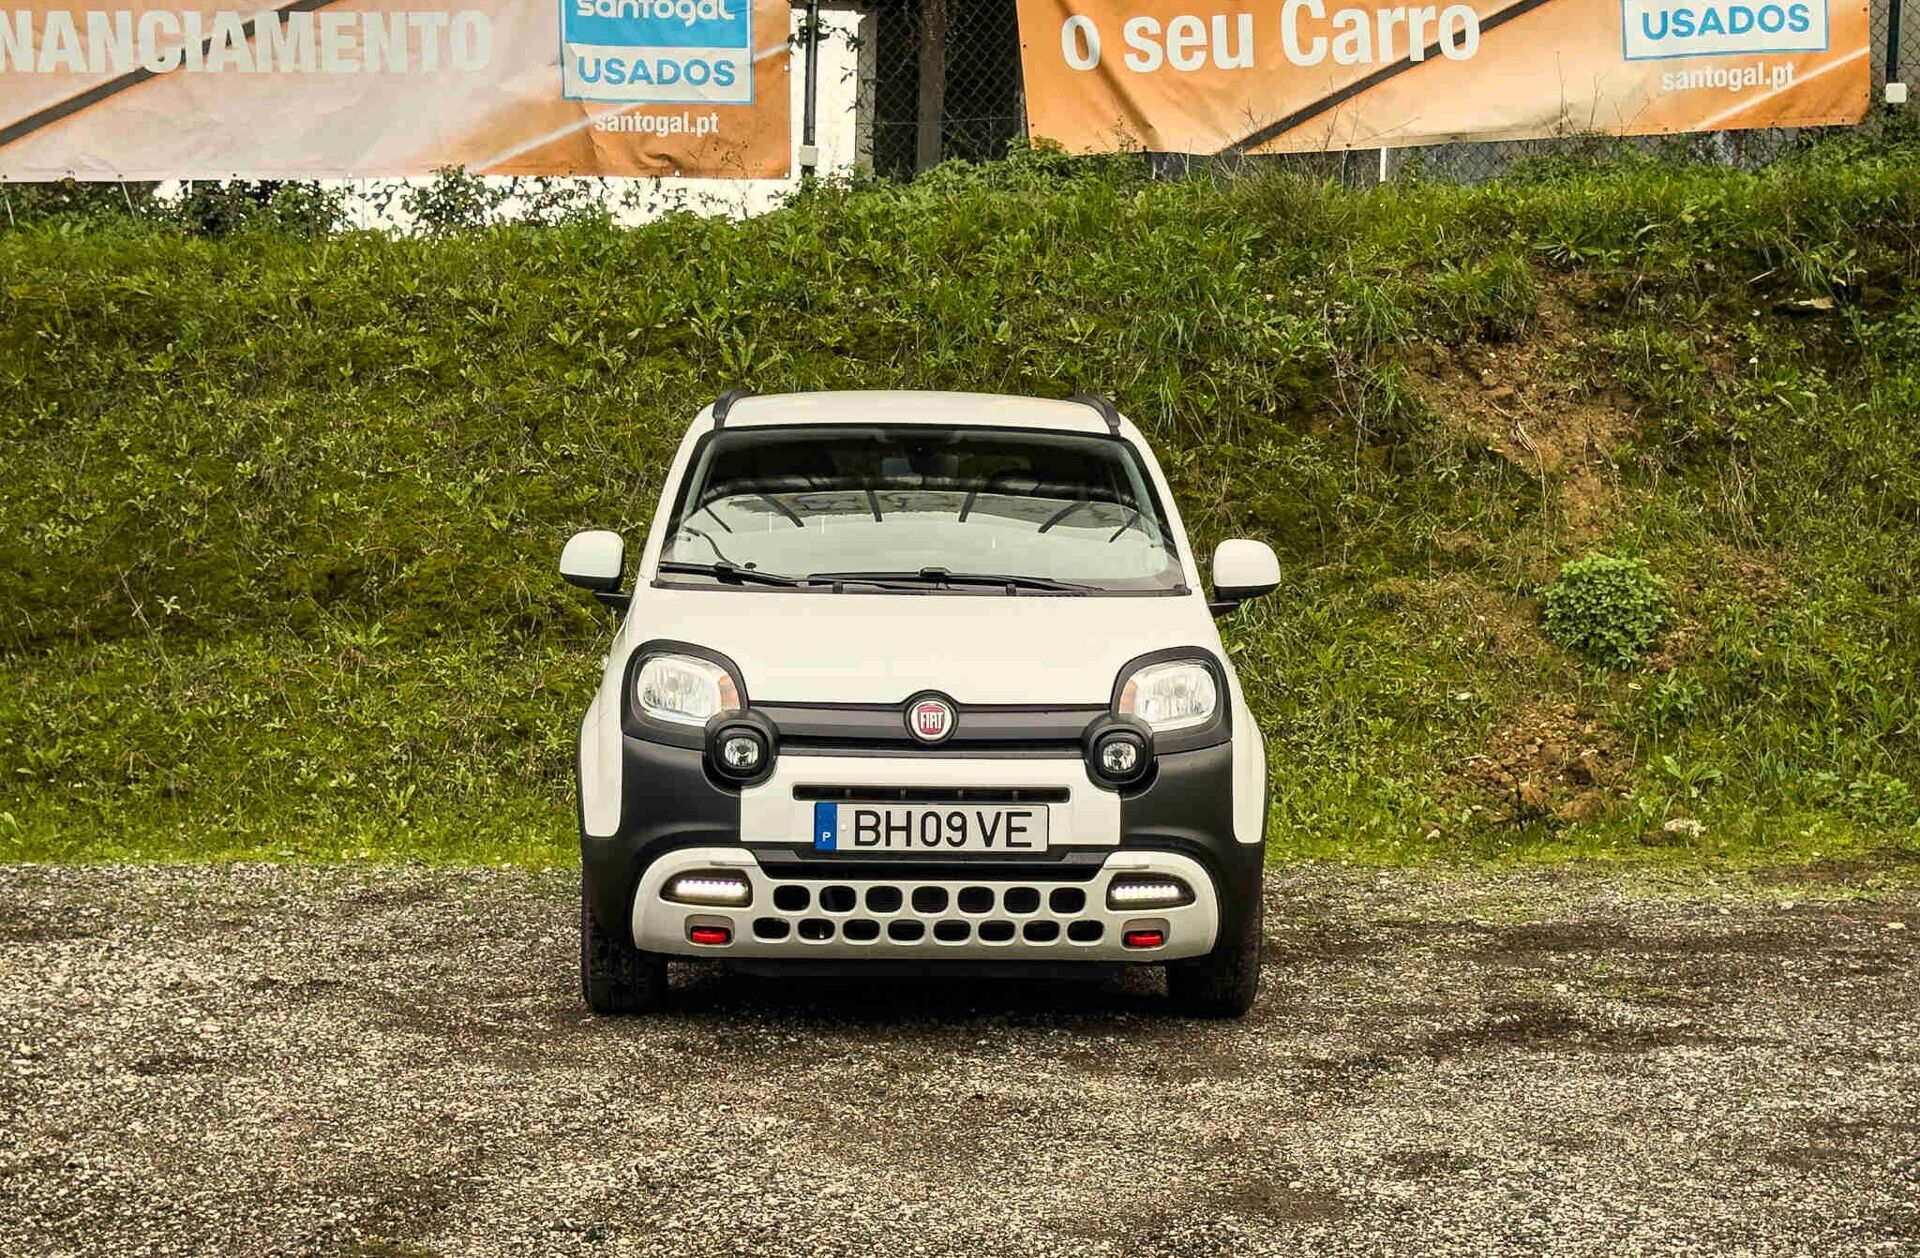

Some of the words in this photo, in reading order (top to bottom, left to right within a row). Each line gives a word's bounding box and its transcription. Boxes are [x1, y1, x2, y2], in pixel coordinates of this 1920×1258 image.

[577, 0, 736, 28] santogal
[1642, 3, 1810, 41] USADOS
[0, 10, 491, 74] NANCIAMENTO
[1061, 15, 1100, 71] o
[1123, 13, 1255, 73] seu
[1280, 0, 1480, 67] Carro
[578, 56, 736, 87] USADOS
[1661, 61, 1796, 92] santogal.pt
[594, 111, 720, 138] santogal.pt
[920, 711, 945, 730] FIAT
[822, 831, 832, 842] P
